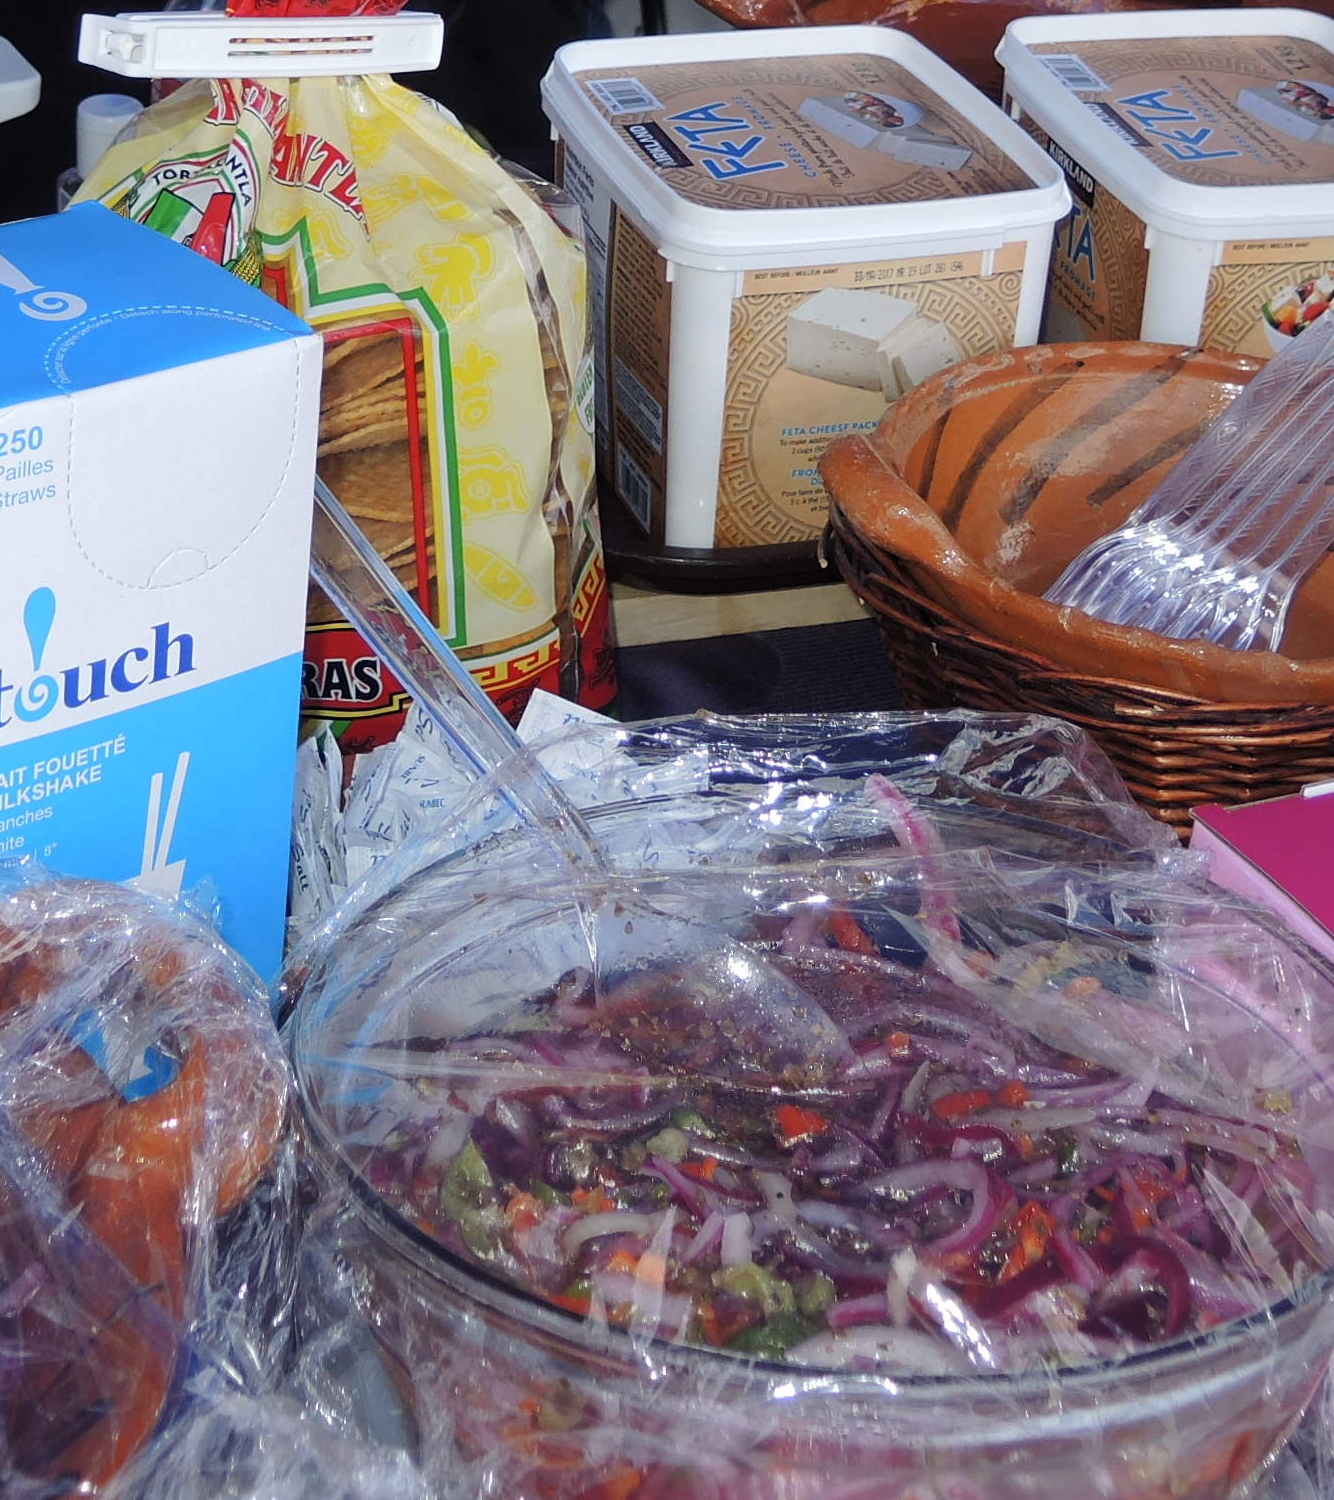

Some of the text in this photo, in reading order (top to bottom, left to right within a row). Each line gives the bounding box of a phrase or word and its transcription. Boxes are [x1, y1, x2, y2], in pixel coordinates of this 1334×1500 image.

[663, 101, 790, 180] FETA
[1117, 88, 1243, 162] FETA
[1049, 140, 1095, 194] KIRKLAND
[781, 427, 806, 437] FETA
[852, 420, 879, 431] PACK
[33, 732, 126, 781] FOUETTÉ
[291, 842, 310, 892] Salt
